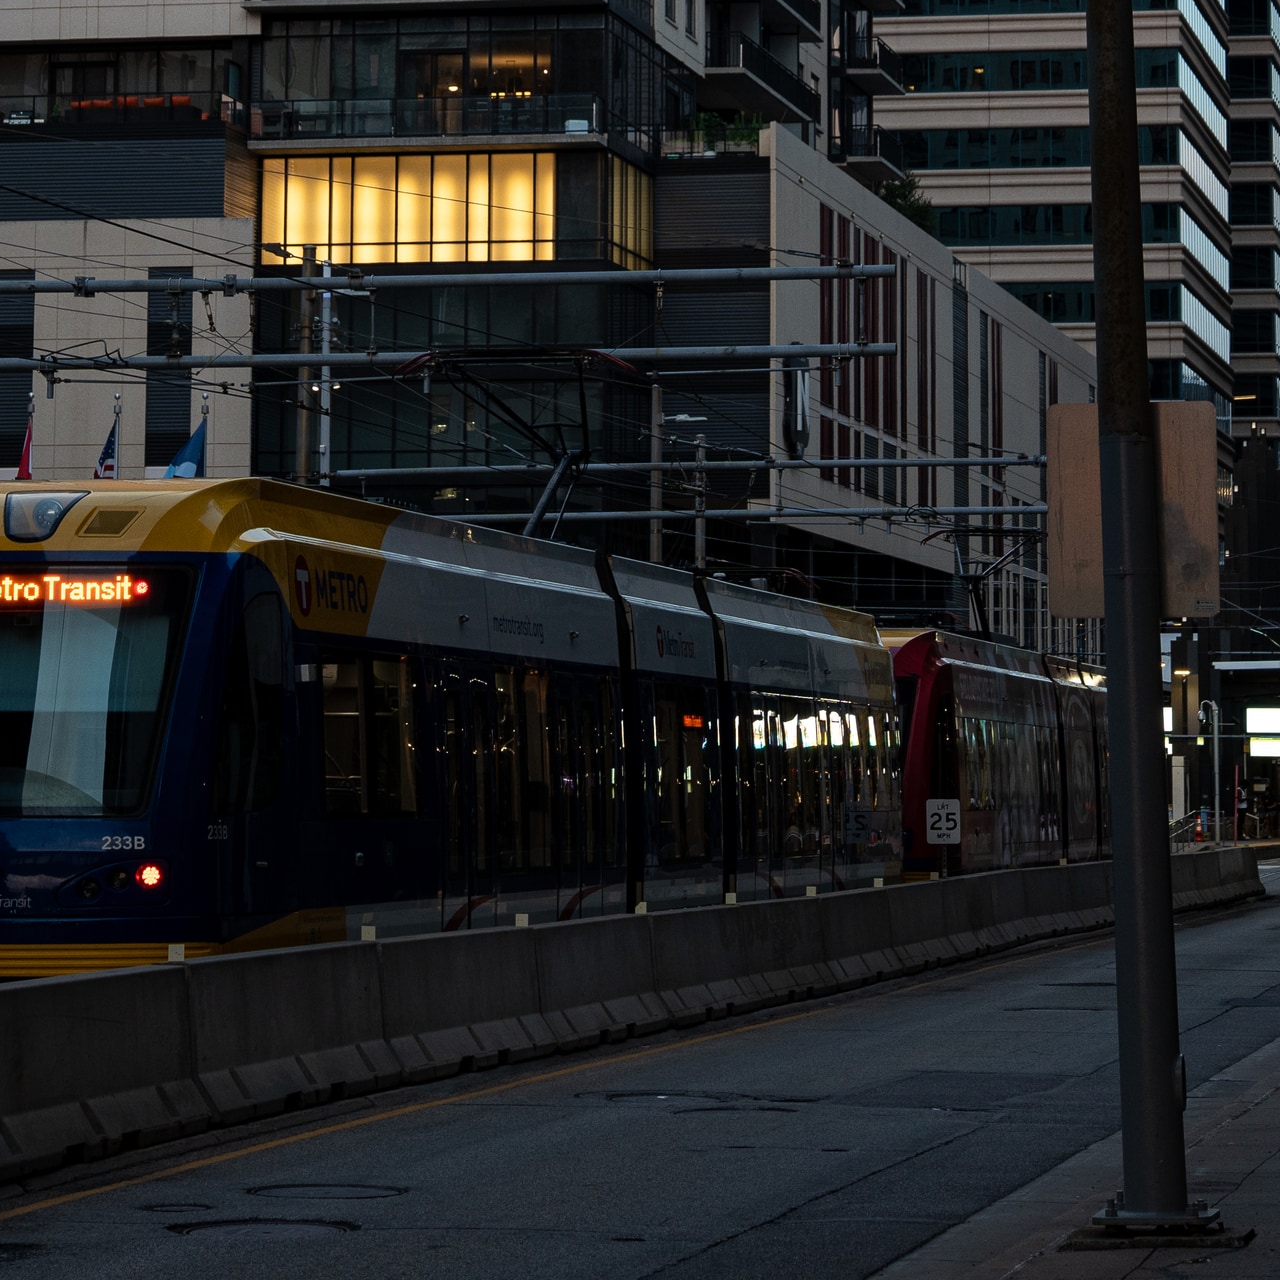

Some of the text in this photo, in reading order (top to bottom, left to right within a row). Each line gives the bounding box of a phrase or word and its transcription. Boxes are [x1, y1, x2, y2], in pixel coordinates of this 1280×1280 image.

[42, 575, 132, 602] Transit
[313, 569, 369, 614] METRO
[491, 614, 545, 646] metrotransit.org
[207, 824, 228, 841] 233B
[929, 812, 958, 831] 25
[100, 835, 146, 852] 233B
